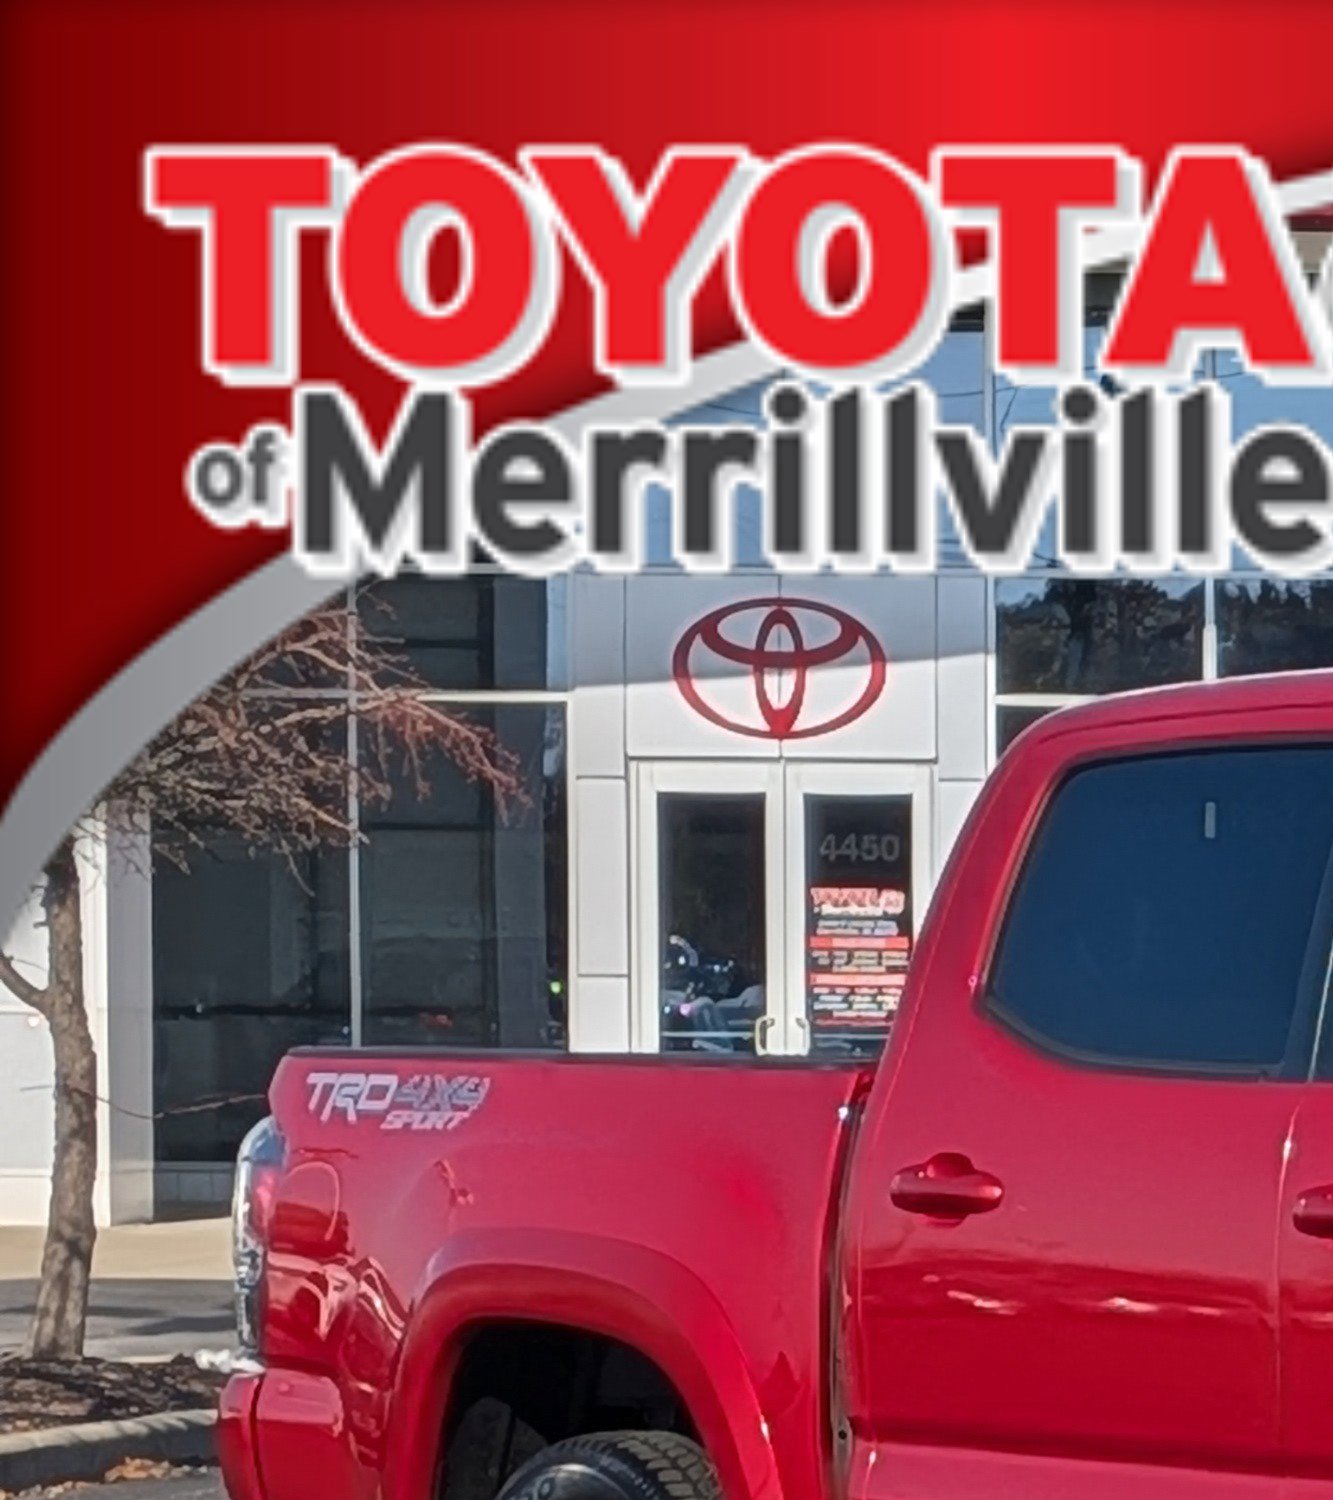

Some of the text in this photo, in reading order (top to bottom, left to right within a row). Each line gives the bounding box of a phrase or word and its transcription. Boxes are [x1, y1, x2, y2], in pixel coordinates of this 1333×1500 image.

[820, 832, 901, 862] 4450
[306, 1072, 399, 1124] TRD
[379, 1109, 470, 1131] SPORT
